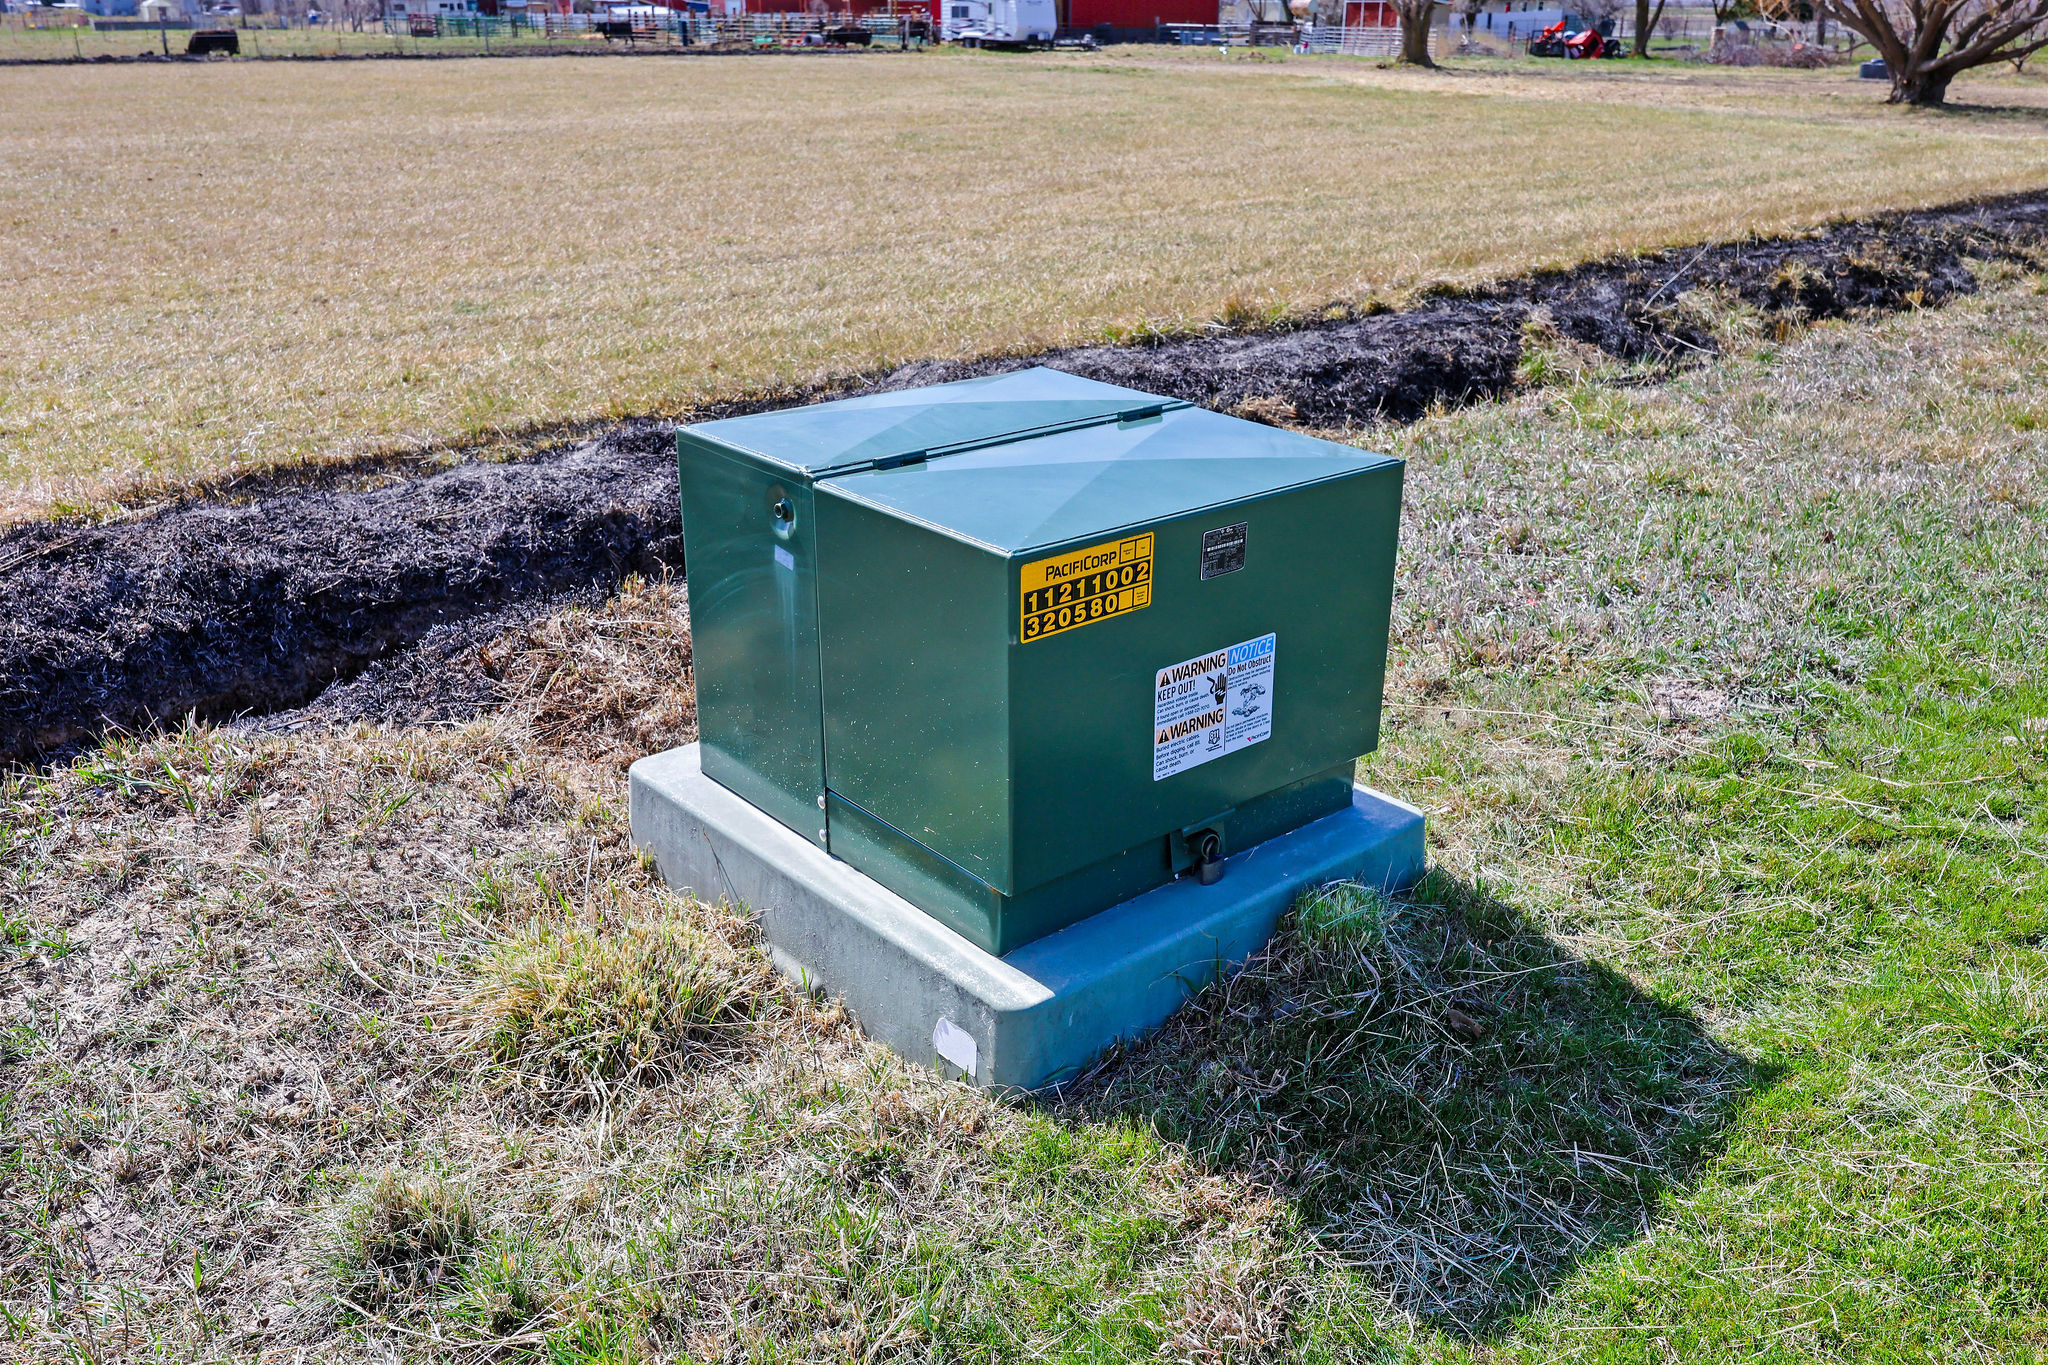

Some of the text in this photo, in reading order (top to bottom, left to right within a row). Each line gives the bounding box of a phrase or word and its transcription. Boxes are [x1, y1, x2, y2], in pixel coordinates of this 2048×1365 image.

[1026, 594, 1118, 637] 320580
[1230, 638, 1273, 664] NOTICE
[1172, 652, 1226, 683] WARNING
[1228, 655, 1271, 676] Do Not Obstruct
[1157, 679, 1196, 703] KEEP OUT!
[1170, 708, 1224, 739] WARNING
